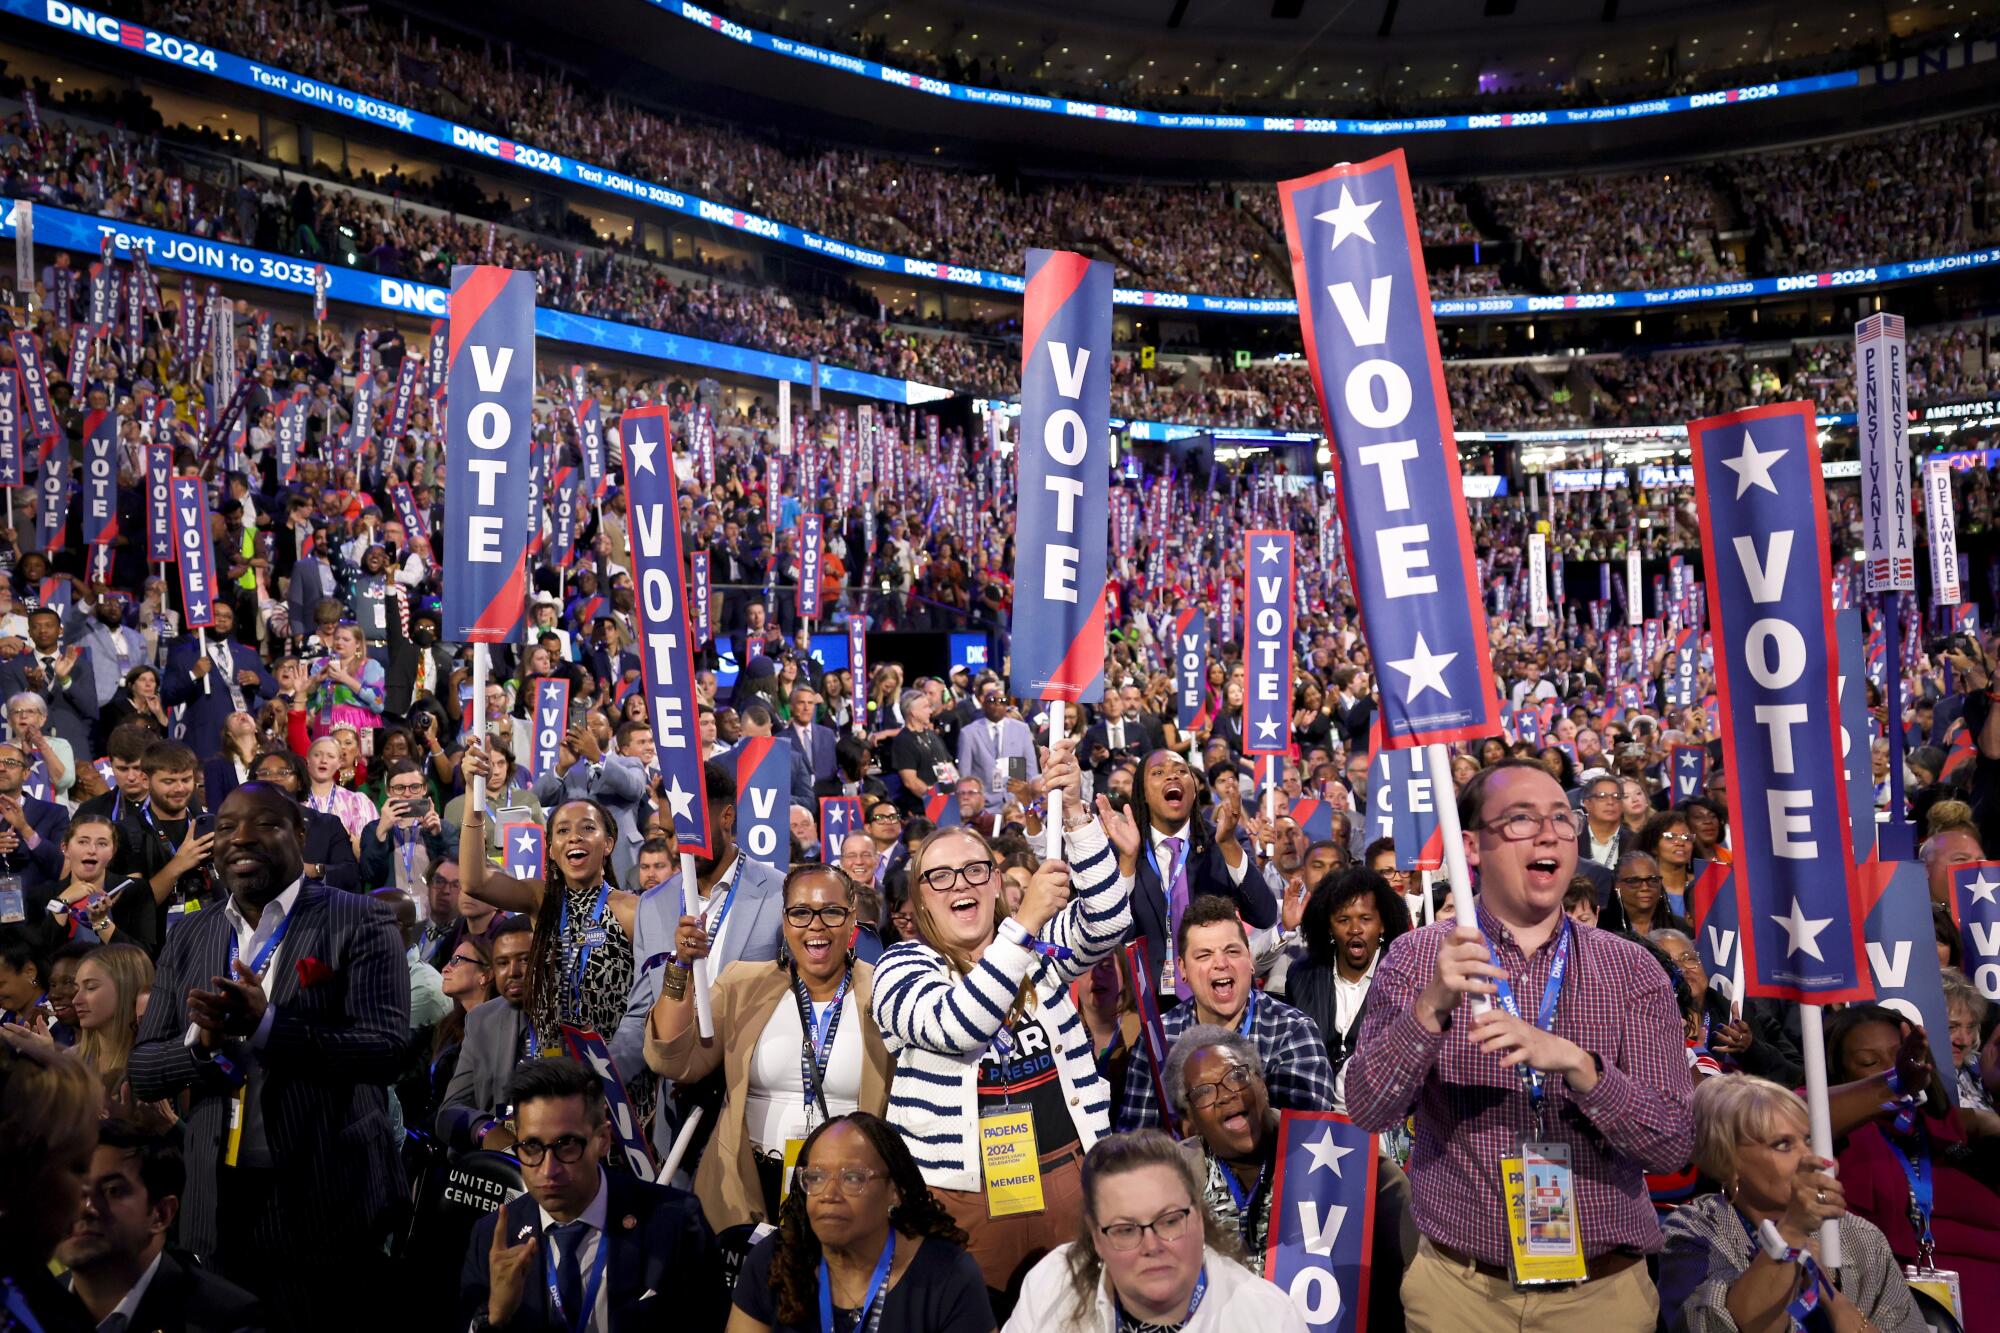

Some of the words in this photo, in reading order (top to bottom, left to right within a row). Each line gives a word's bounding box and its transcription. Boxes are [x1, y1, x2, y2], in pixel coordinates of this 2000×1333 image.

[47, 0, 119, 41] DNC
[146, 33, 217, 70] 2024
[683, 3, 712, 26] DNC
[720, 20, 752, 42] 2024
[250, 66, 287, 89] Text
[292, 81, 332, 103] JOIN
[454, 126, 500, 155] DNC
[515, 146, 561, 173] 2024
[700, 201, 735, 225] DNC
[741, 215, 779, 237] 2024
[162, 241, 223, 267] JOIN
[107, 279, 119, 318] VOTE
[201, 295, 214, 337] VOTE
[315, 271, 326, 310] VOTE
[381, 279, 449, 314] DNC
[21, 352, 46, 412] VOTE
[72, 339, 88, 385] VOTE
[224, 311, 234, 399] VIRGINI
[432, 334, 445, 384] VOTE
[0, 391, 13, 458] VOTE
[294, 404, 305, 442] VOTE
[357, 388, 371, 438] VOTE
[395, 373, 413, 419] VOTE
[1925, 401, 1994, 420] AMERICA'S
[280, 416, 292, 464] VOTE
[466, 345, 514, 563] VOTE
[584, 419, 601, 478] VOTE
[861, 414, 870, 472] NEVADA
[1327, 274, 1438, 600] VOTE
[1865, 347, 1884, 551] PENNSYLVANIA
[1891, 345, 1907, 549] PENNSYLVANIA
[45, 460, 61, 528] VOTE
[91, 438, 110, 518] VOTE
[153, 468, 168, 534] VOTE
[528, 467, 539, 532] VOTE
[842, 456, 853, 495] VOTE
[1044, 341, 1091, 604] VOTE
[399, 501, 420, 538] VOT
[558, 487, 573, 547] VOTE
[1926, 479, 1940, 585] DELAWARE
[1938, 477, 1955, 583] DELAWARE
[181, 507, 204, 592] VOTE
[803, 535, 818, 593] VOTE
[1147, 551, 1159, 591] VOTE
[1867, 560, 1875, 588] DNC
[635, 503, 686, 749] VOTE
[697, 570, 708, 630] VOTE
[1256, 576, 1283, 701] VOTE
[854, 636, 865, 700] VOTE
[1183, 633, 1200, 708] VOTE
[1681, 648, 1694, 706] VOTE
[1732, 530, 1820, 859] VOTE
[539, 707, 560, 772] VOT
[747, 786, 778, 855] VO
[1551, 957, 1564, 979] DNC
[1969, 921, 2000, 1001] VO
[811, 1024, 819, 1041] DNC
[1503, 995, 1519, 1017] DNC
[604, 1096, 657, 1183] VO
[986, 1143, 1015, 1157] 2024
[444, 1186, 500, 1213] CENTER
[449, 1169, 504, 1197] UNITED
[990, 1175, 1036, 1189] MEMBER
[1289, 1201, 1349, 1325] VO
[549, 1284, 561, 1308] DNC
[1190, 1284, 1204, 1312] 2024
